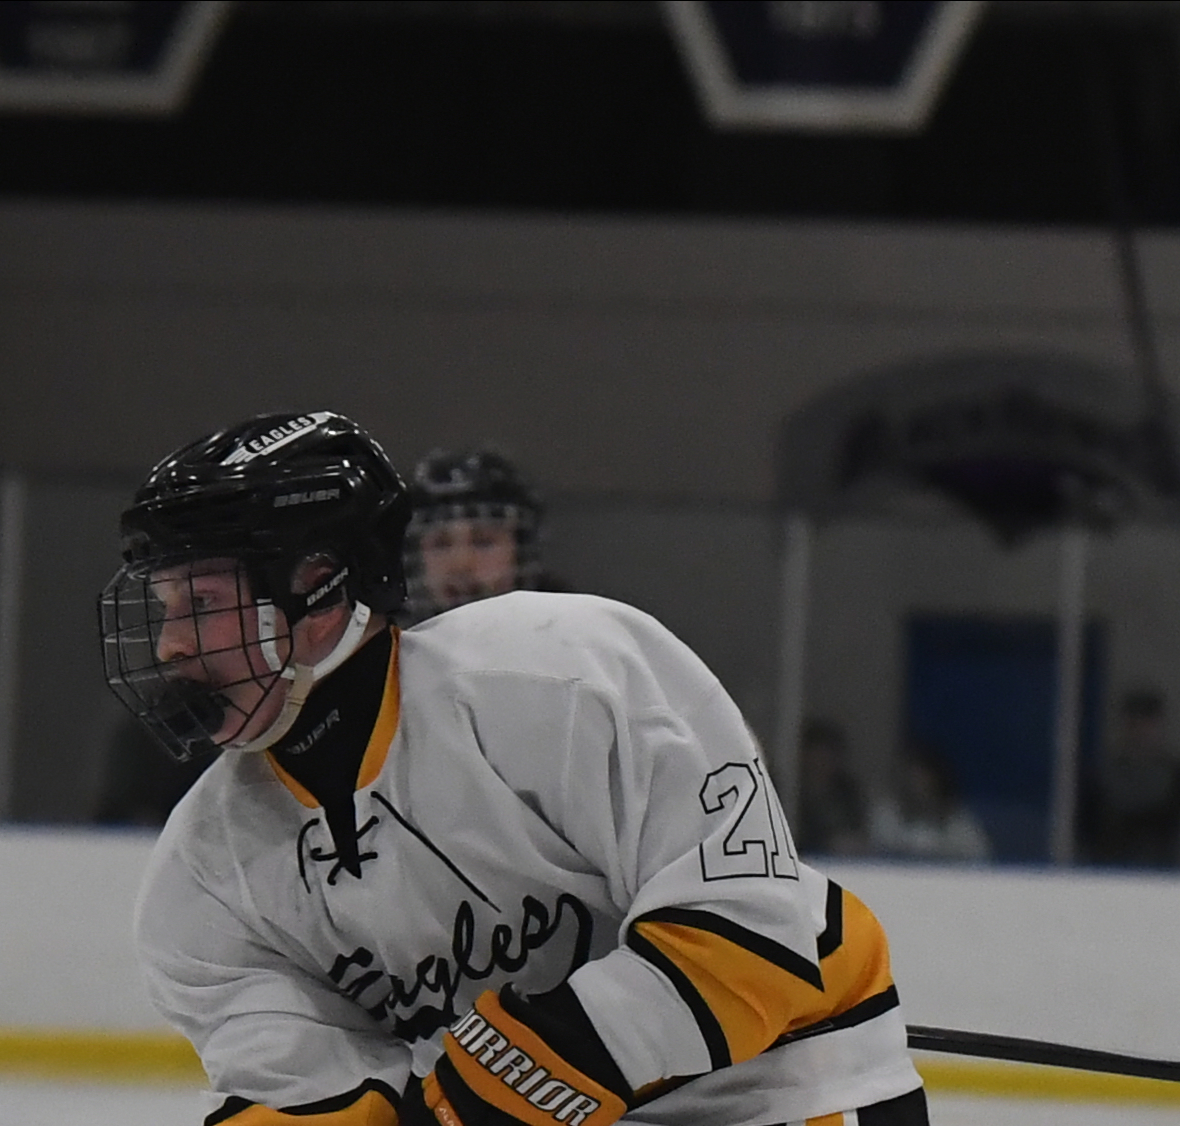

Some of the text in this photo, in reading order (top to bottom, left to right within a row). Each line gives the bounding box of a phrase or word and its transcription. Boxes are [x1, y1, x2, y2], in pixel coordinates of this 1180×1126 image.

[248, 416, 313, 452] EAGLES
[273, 488, 340, 508] BAUER
[306, 567, 350, 607] BAUER
[286, 708, 341, 755] AUER
[699, 757, 800, 882] 21
